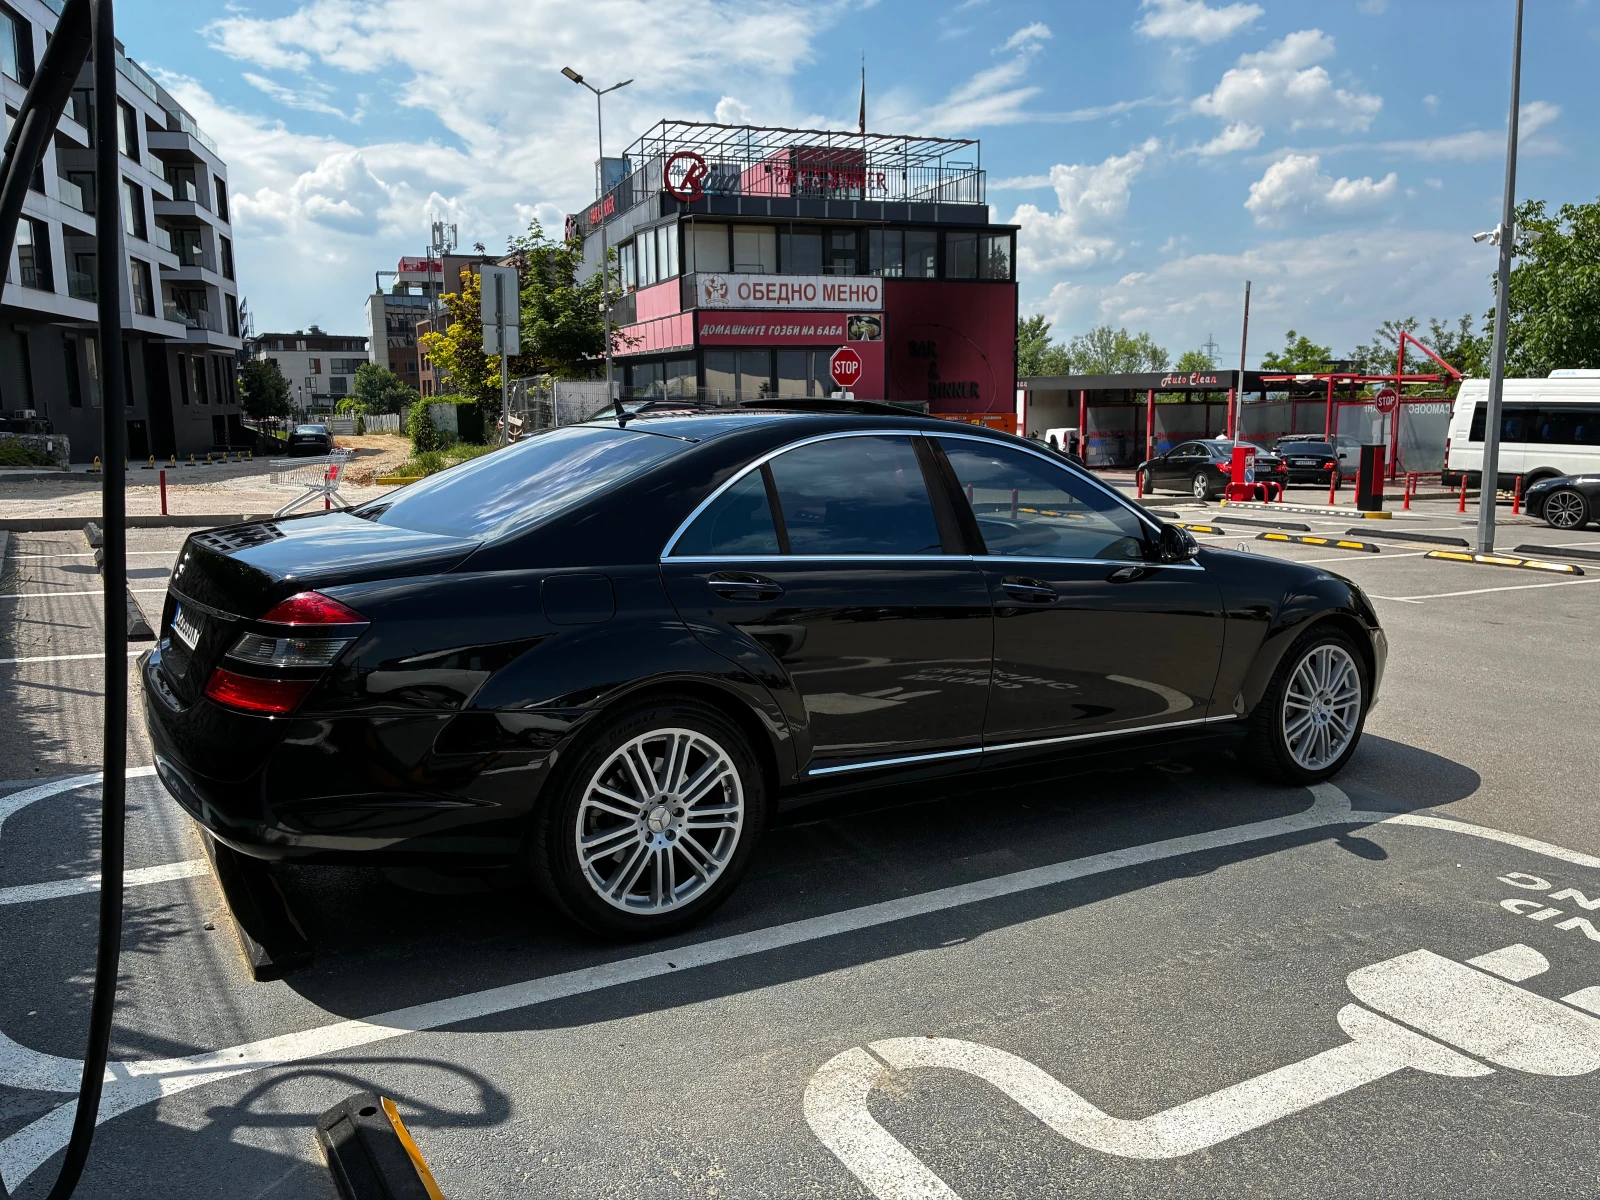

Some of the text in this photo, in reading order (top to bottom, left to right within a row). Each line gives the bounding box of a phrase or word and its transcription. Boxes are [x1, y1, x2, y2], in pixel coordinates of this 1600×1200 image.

[737, 282, 878, 304] ОБЕДНО МЕНЮ
[700, 323, 843, 336] ДОМАШНИТЕ ГОЗБИ НА БАБА
[834, 361, 859, 374] STOP
[1161, 372, 1217, 387] Auto Clean
[928, 381, 980, 399] DINNER
[1378, 396, 1395, 406] STOP
